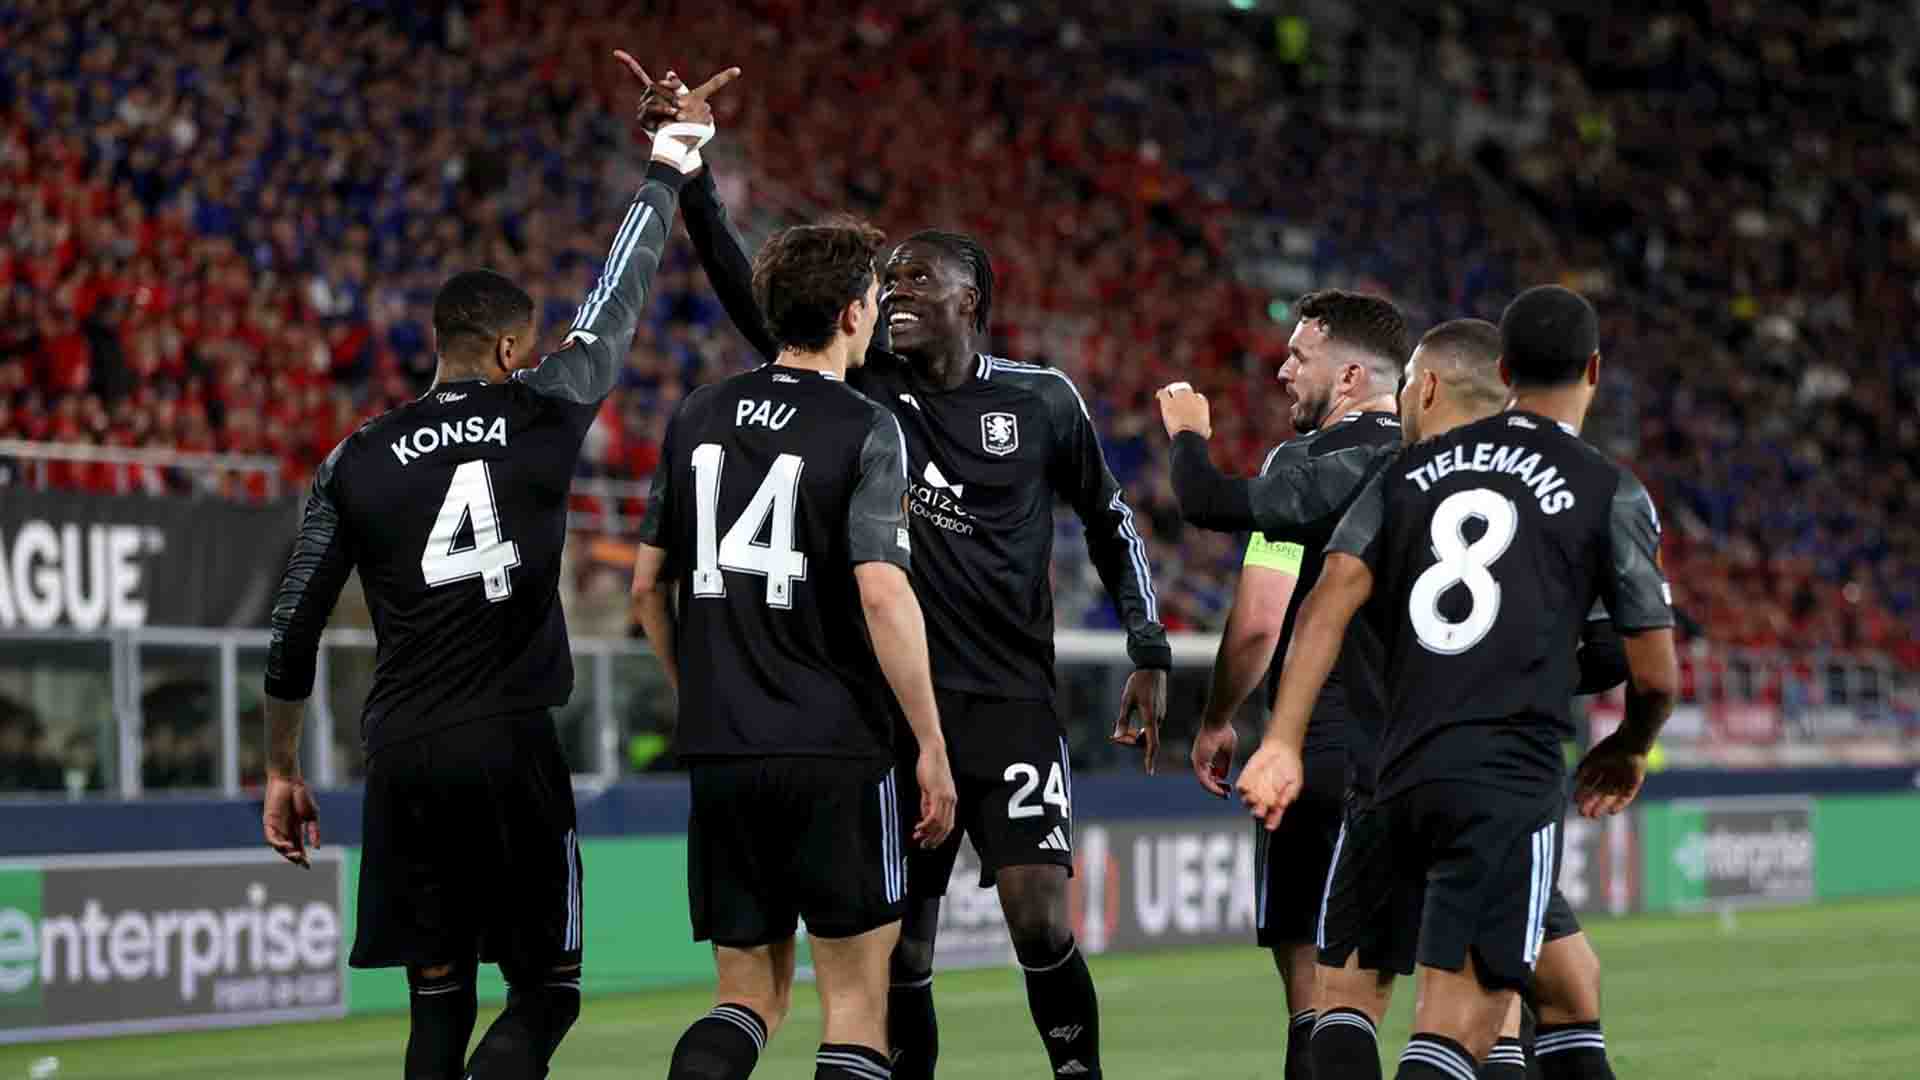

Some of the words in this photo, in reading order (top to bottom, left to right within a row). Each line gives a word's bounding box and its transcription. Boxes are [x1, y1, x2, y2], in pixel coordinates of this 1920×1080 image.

[391, 416, 507, 465] KONSA
[736, 400, 797, 431] PAU
[909, 484, 977, 520] kaize
[1405, 443, 1575, 515] TIELEMANS
[421, 459, 521, 603] 4
[691, 443, 808, 610] 14
[1409, 488, 1518, 655] 8
[1003, 761, 1068, 819] 24
[0, 882, 337, 1000] enterprise
